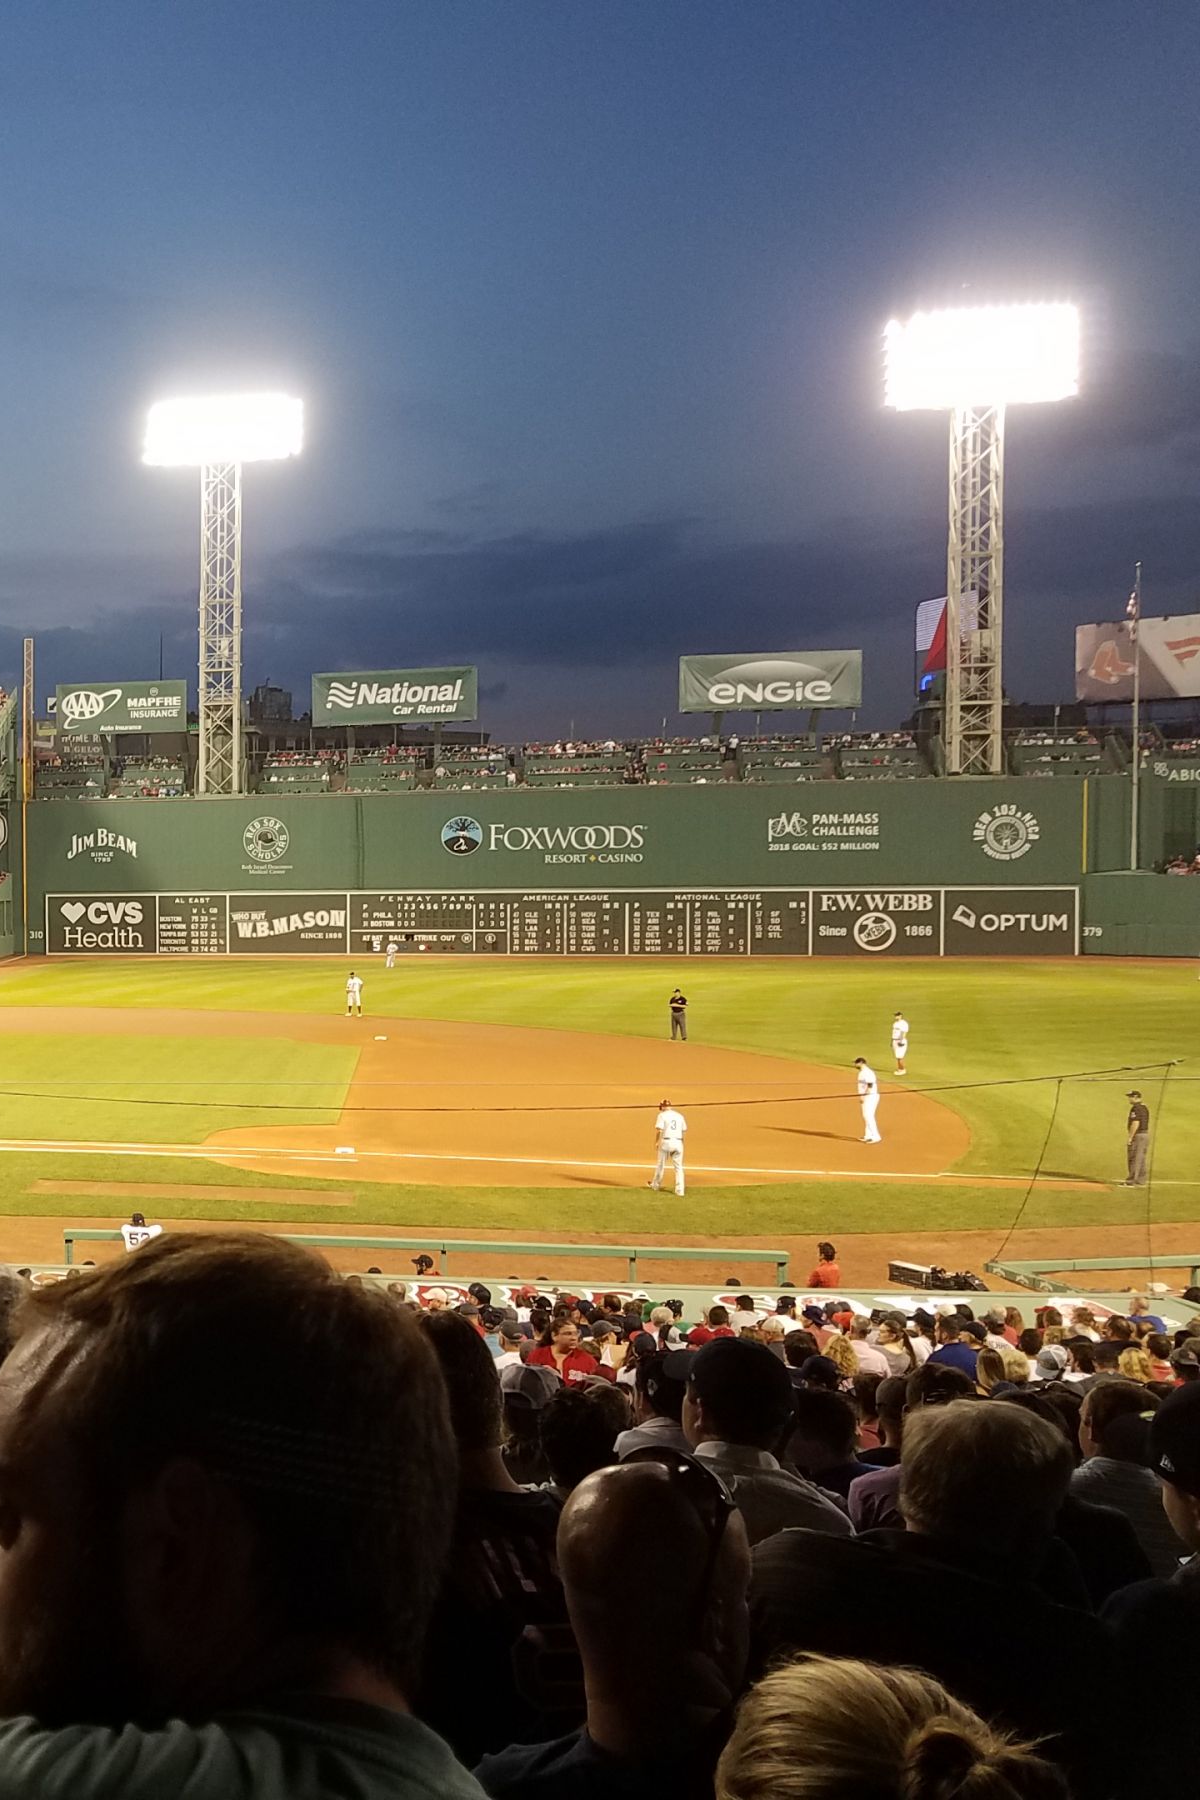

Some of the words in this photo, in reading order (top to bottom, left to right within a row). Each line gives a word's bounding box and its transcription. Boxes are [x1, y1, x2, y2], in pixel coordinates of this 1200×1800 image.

[67, 692, 98, 717] AAA
[127, 696, 181, 707] MAPFRE
[131, 709, 179, 718] INSURANCE
[393, 706, 414, 715] Car
[417, 703, 457, 714] Rental
[992, 804, 1016, 816] 103
[813, 813, 879, 824] PAN-MASS
[246, 822, 260, 838] RED
[263, 819, 281, 830] SOX
[813, 826, 879, 836] CHALLENGE
[488, 824, 644, 850] FOXWOODS
[67, 833, 94, 859] JIM
[97, 828, 137, 858] BEAM
[248, 835, 286, 859] SCHOLARS
[840, 842, 879, 850] MILLION
[545, 854, 586, 863] RESORT
[599, 854, 643, 863] CASINO
[820, 894, 861, 911] F.W.
[864, 894, 933, 911] WEBB
[88, 902, 143, 924] CVS
[980, 914, 1068, 931] OPTUM
[30, 931, 43, 939] 310
[819, 925, 847, 936] Since
[904, 925, 932, 936] 1866
[1083, 927, 1102, 936] 379
[64, 927, 144, 947] Health
[373, 942, 380, 951] 5
